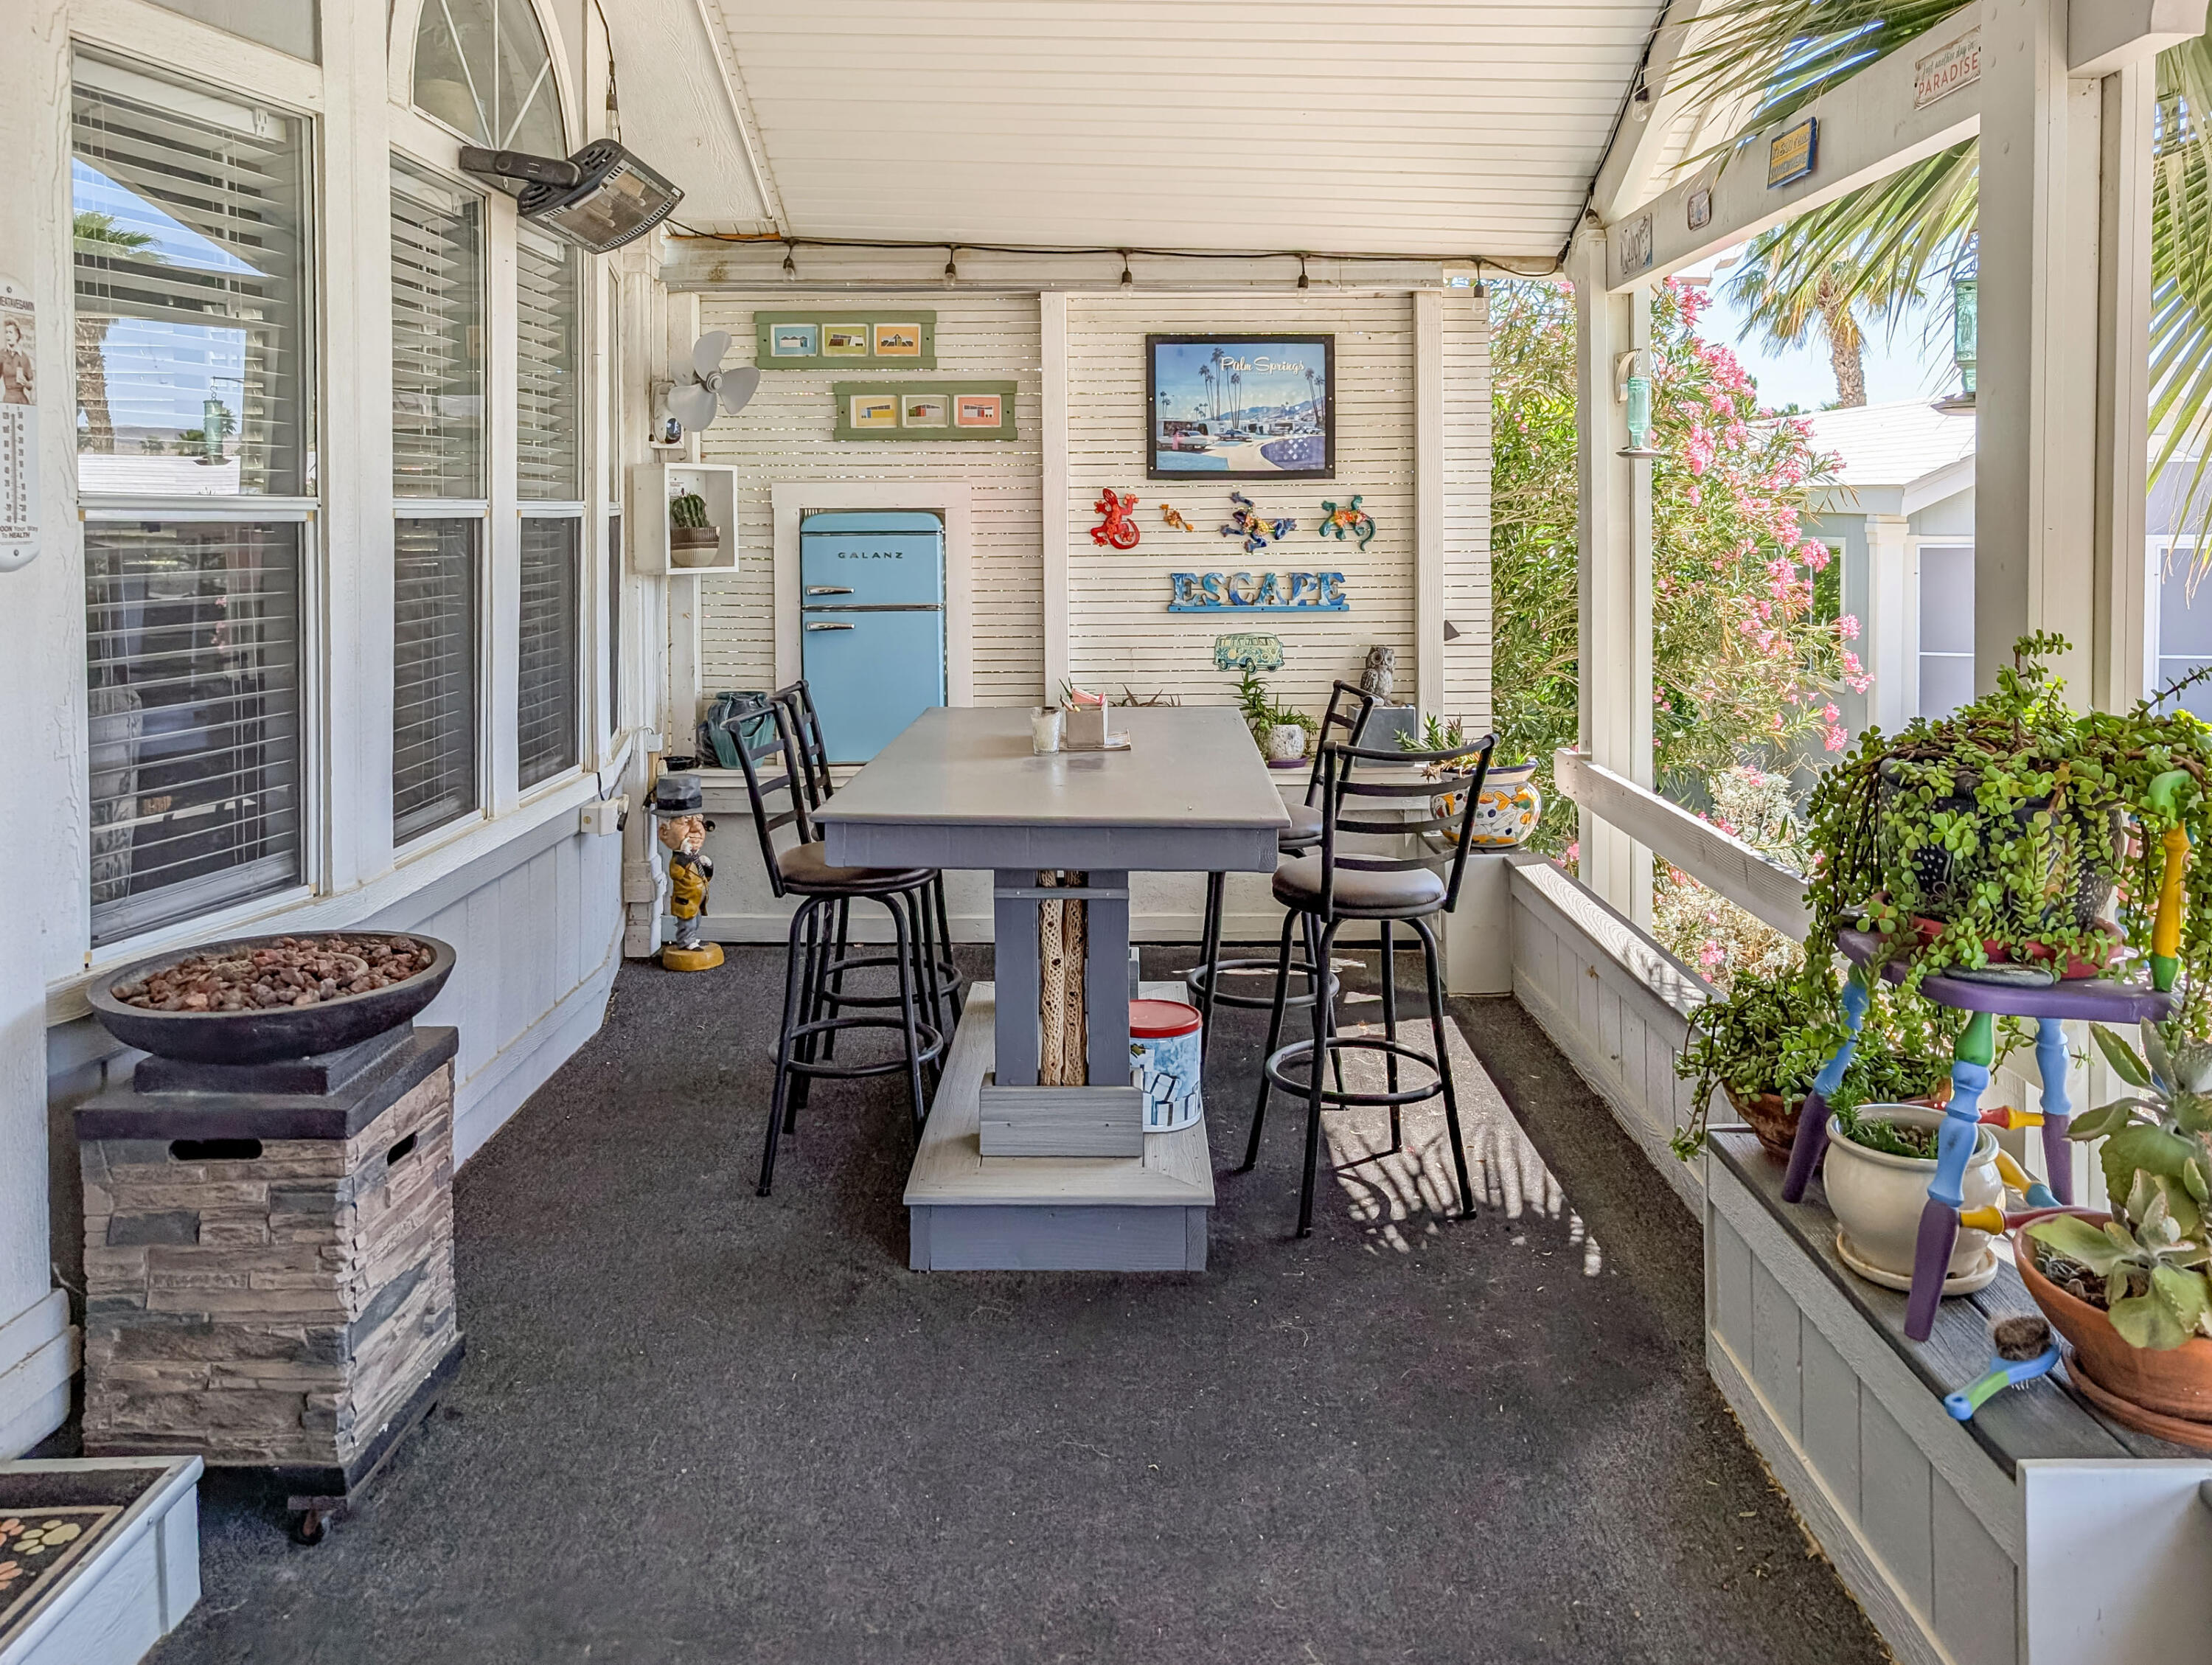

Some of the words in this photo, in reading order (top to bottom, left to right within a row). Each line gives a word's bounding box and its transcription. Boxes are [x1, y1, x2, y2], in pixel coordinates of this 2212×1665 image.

[1935, 52, 1955, 69] another
[1955, 44, 1966, 59] day
[1968, 41, 1975, 52] in
[1919, 52, 1978, 99] PARADISE
[1220, 356, 1253, 372] Palm
[1253, 356, 1304, 375] Springs
[838, 552, 904, 560] GALANZ
[1169, 571, 1346, 607] ESCAPE
